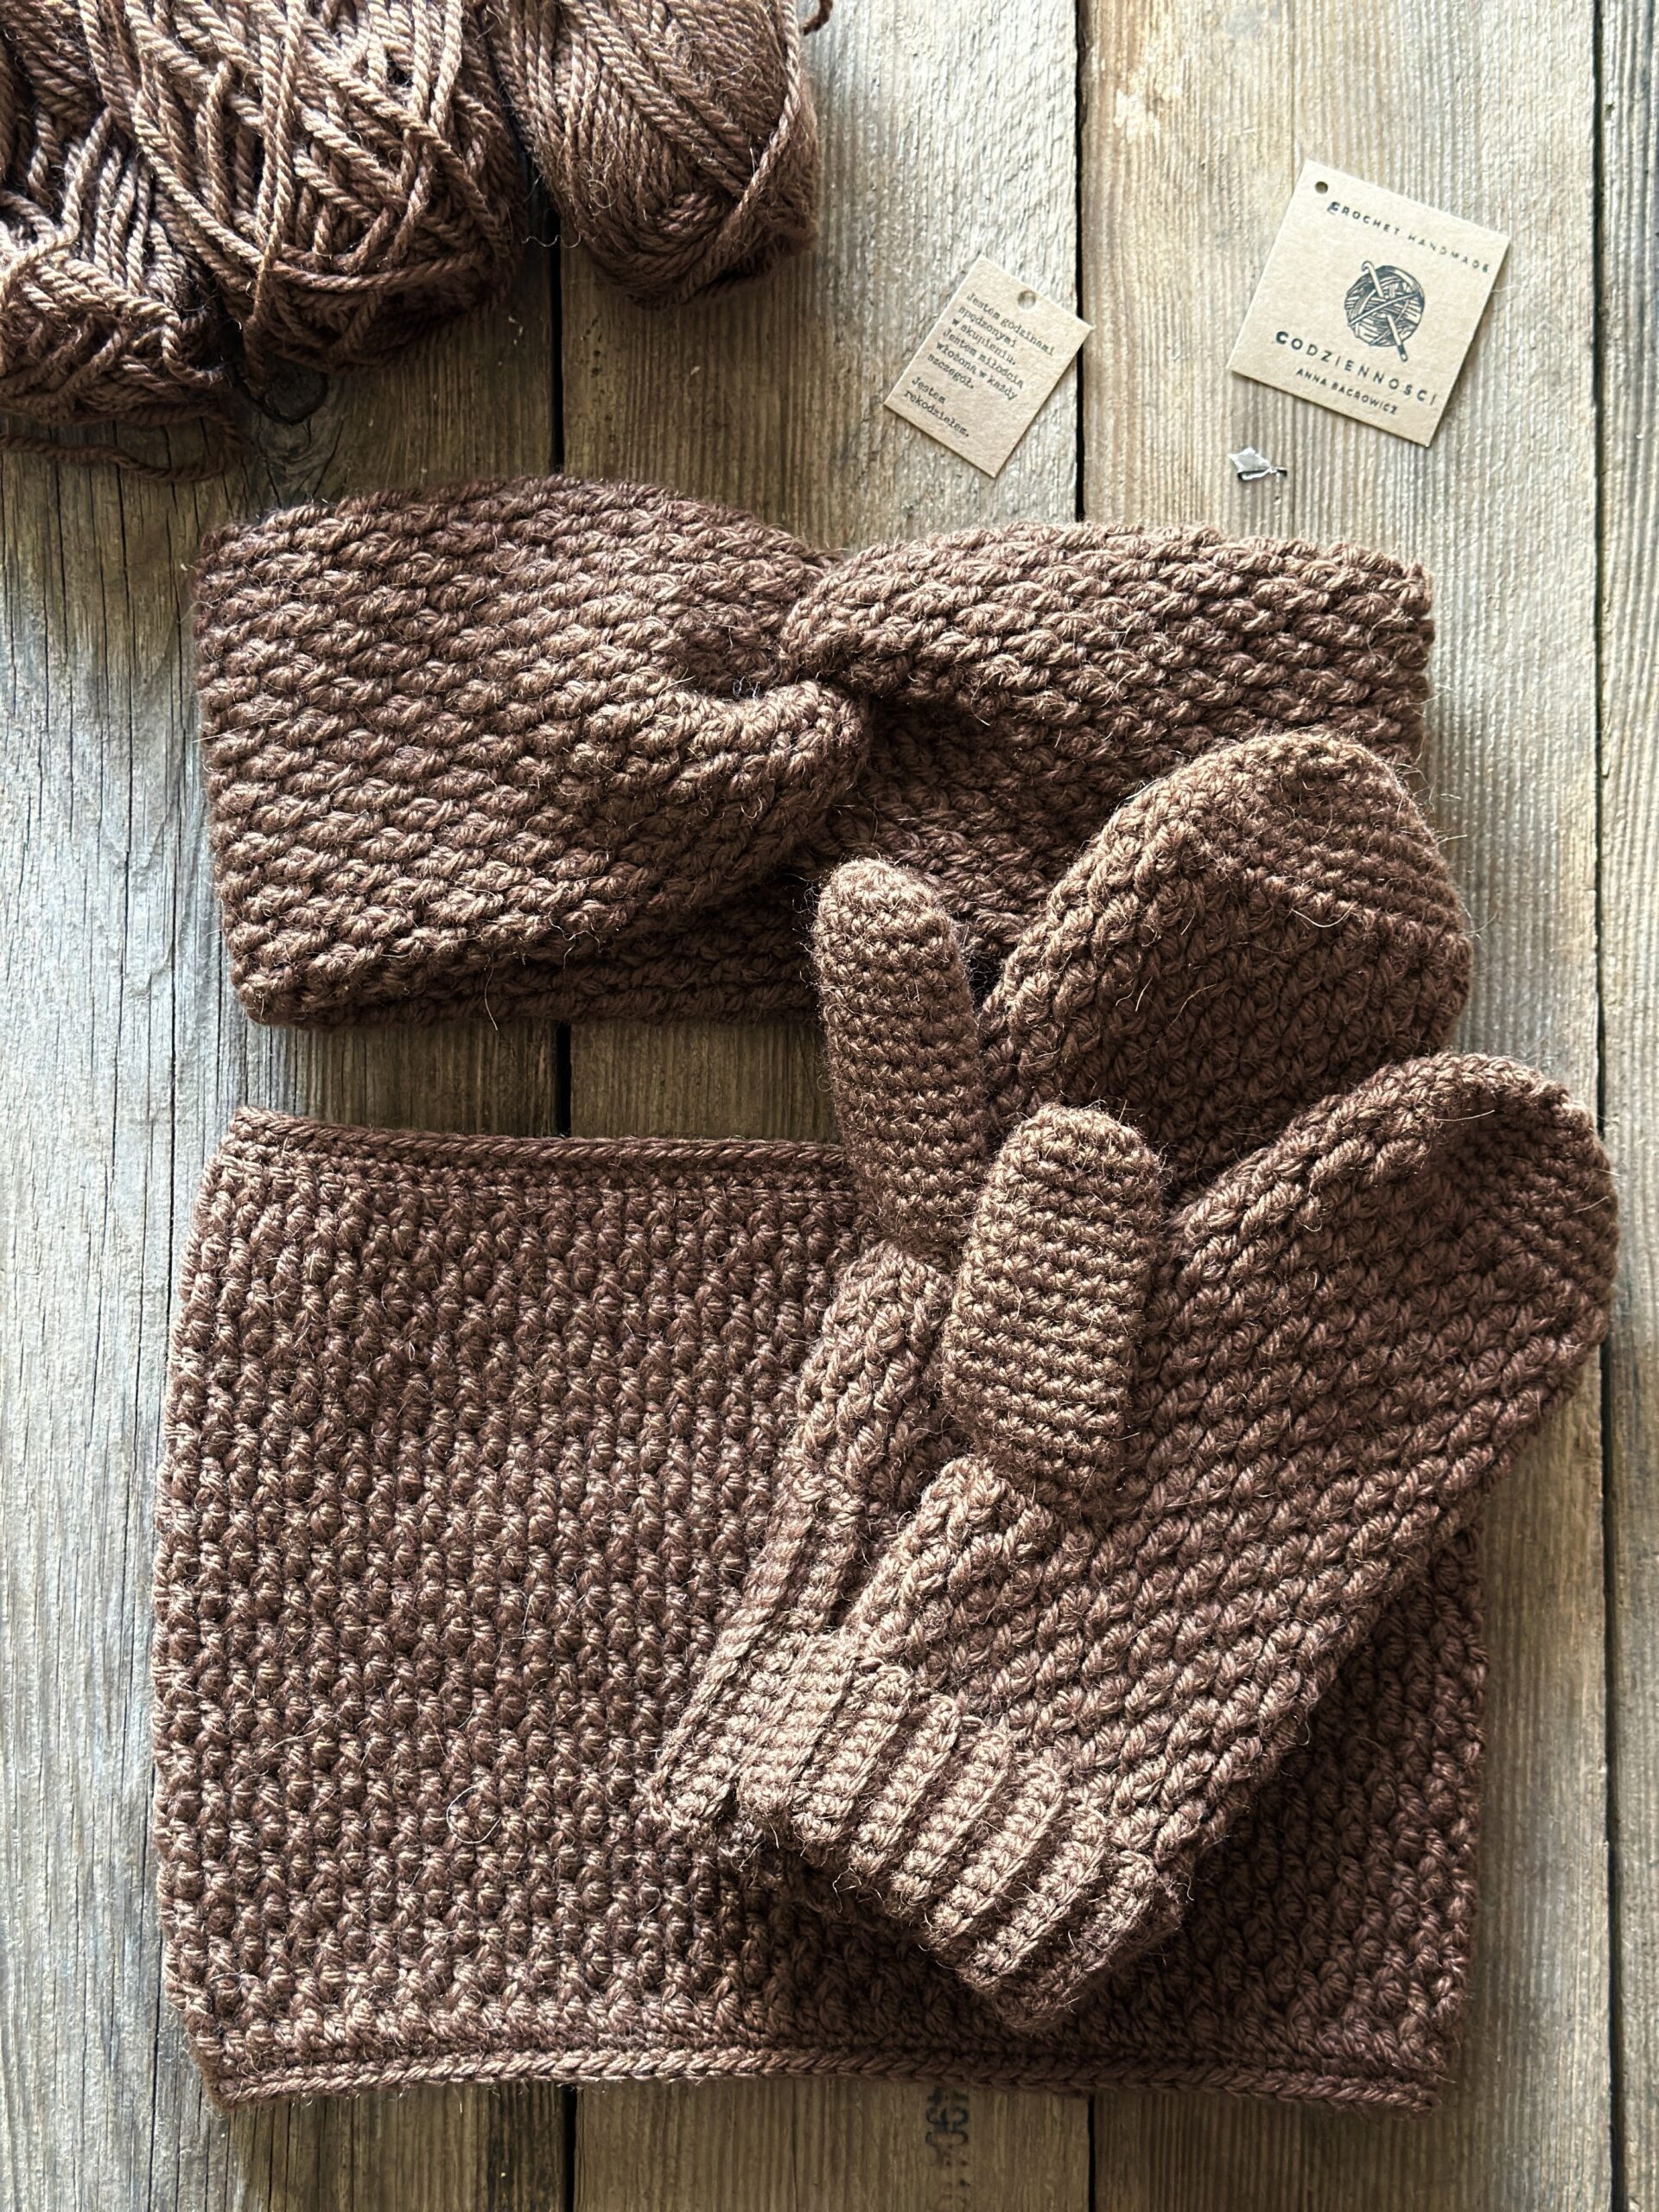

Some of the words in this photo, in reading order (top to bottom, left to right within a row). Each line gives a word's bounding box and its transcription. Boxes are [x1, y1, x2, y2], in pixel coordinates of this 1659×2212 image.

[966, 292, 1001, 321] Jestem
[1001, 316, 1055, 356] godzinami
[943, 328, 976, 357] Jestem
[912, 376, 946, 404] Jestem
[987, 374, 1018, 401] każdy
[1294, 366, 1328, 388] ANNA
